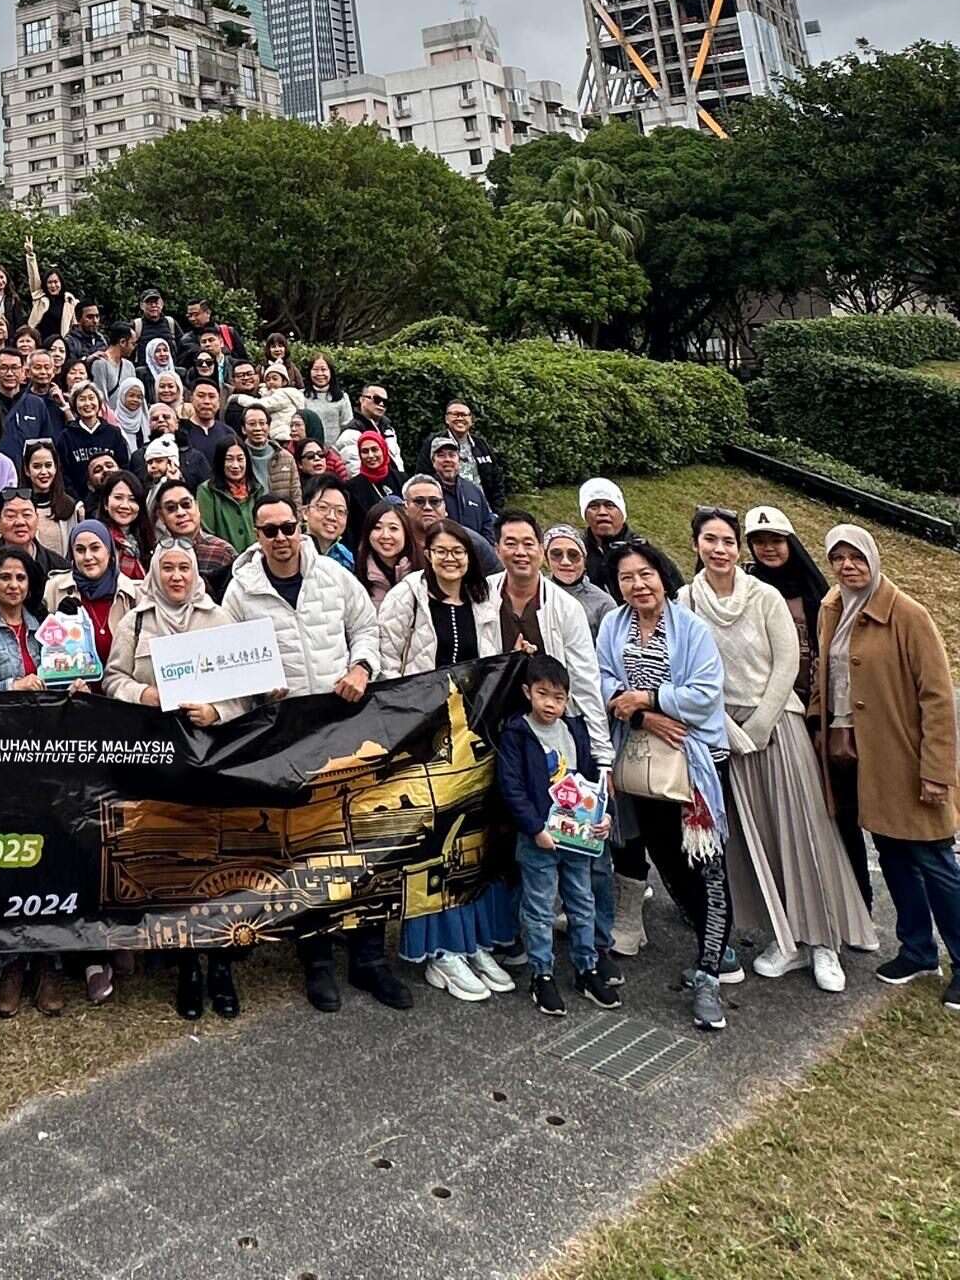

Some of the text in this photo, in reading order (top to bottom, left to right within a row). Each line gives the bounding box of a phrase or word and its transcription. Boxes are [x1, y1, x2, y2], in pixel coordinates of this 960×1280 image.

[758, 512, 770, 524] A
[160, 662, 194, 680] taipei
[44, 740, 98, 753] AKITEK
[102, 741, 176, 754] MALAYSIA
[13, 752, 76, 763] INSTITUTE
[78, 753, 96, 763] OF
[96, 754, 174, 764] ARCHITECTS
[3, 892, 79, 918] 2024
